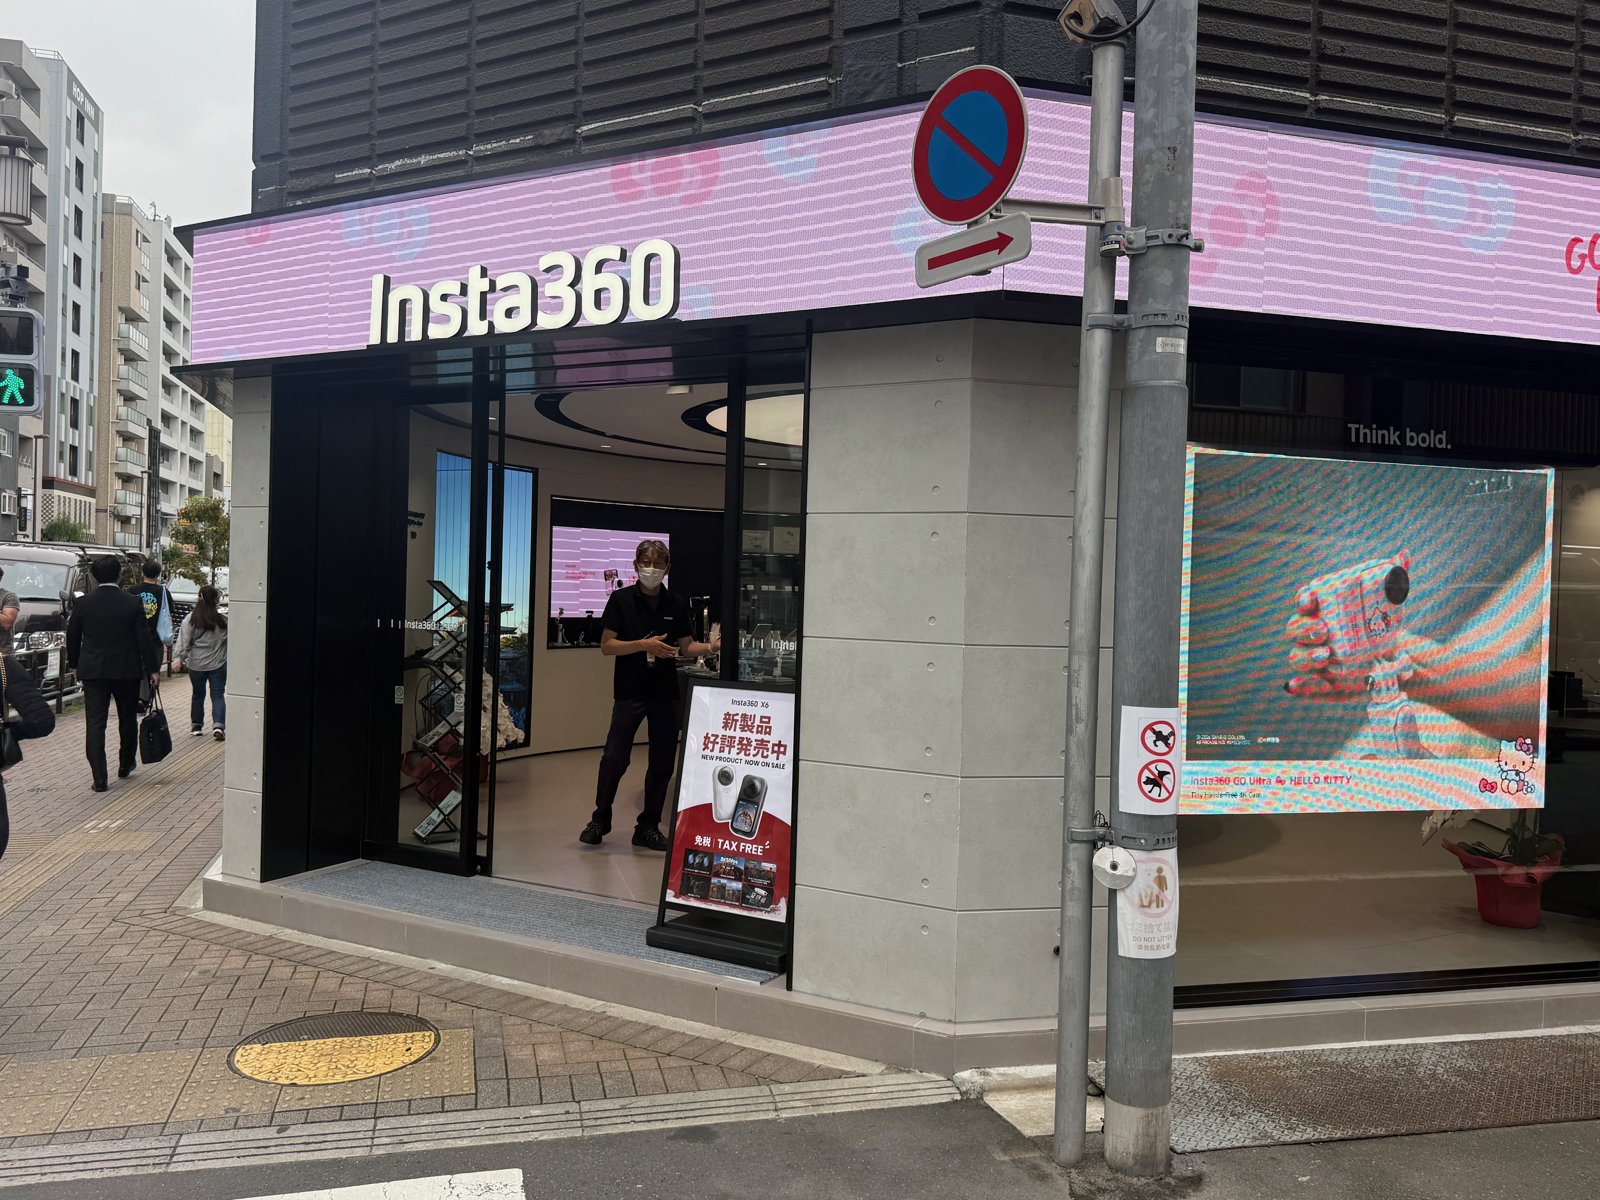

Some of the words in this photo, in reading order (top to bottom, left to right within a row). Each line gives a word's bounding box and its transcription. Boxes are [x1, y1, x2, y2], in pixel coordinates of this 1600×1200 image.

[73, 81, 84, 105] HOP
[85, 97, 94, 120] INN
[369, 239, 680, 344] Insta360
[1347, 424, 1401, 446] Think
[1406, 427, 1451, 449] bold.
[404, 619, 436, 631] Insta360
[731, 698, 758, 708] Insta360
[721, 711, 773, 736] 新製品
[702, 732, 788, 761] 好評発売中
[715, 755, 742, 764] PRODUCT
[744, 759, 760, 767] NOW
[760, 760, 770, 768] ON
[771, 762, 785, 770] SALE
[1191, 776, 1230, 786] Insta360
[1233, 776, 1246, 786] GO
[1249, 776, 1272, 786] Ultra
[1290, 776, 1320, 785] HELLO
[1323, 775, 1352, 785] KITTY
[694, 834, 711, 848] 免税
[717, 838, 738, 852] TAX
[739, 842, 764, 856] FREE
